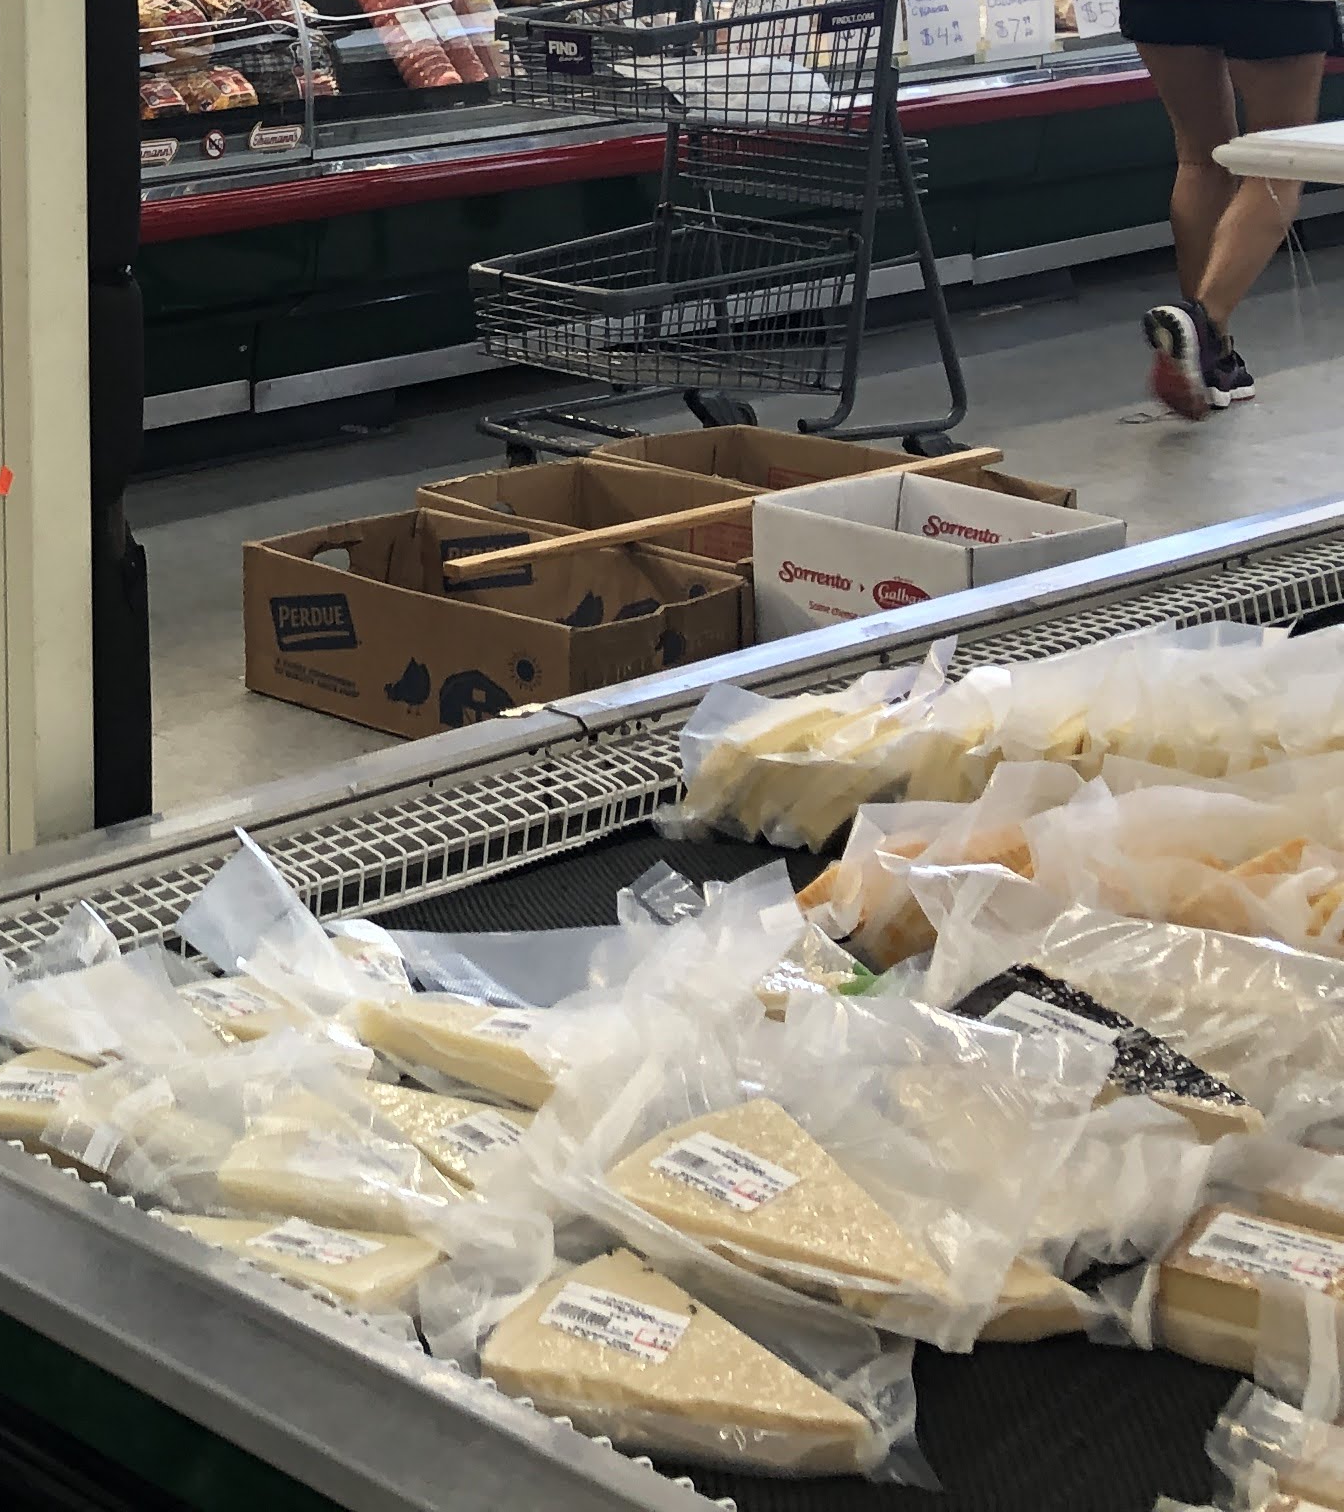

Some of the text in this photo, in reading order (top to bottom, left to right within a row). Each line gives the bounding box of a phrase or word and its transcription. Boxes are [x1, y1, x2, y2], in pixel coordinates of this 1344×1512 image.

[548, 40, 578, 57] FIND
[253, 130, 298, 149] Thumann's
[922, 515, 1000, 544] Sorrento
[779, 561, 853, 591] Sorrento
[278, 605, 344, 628] PERDUE
